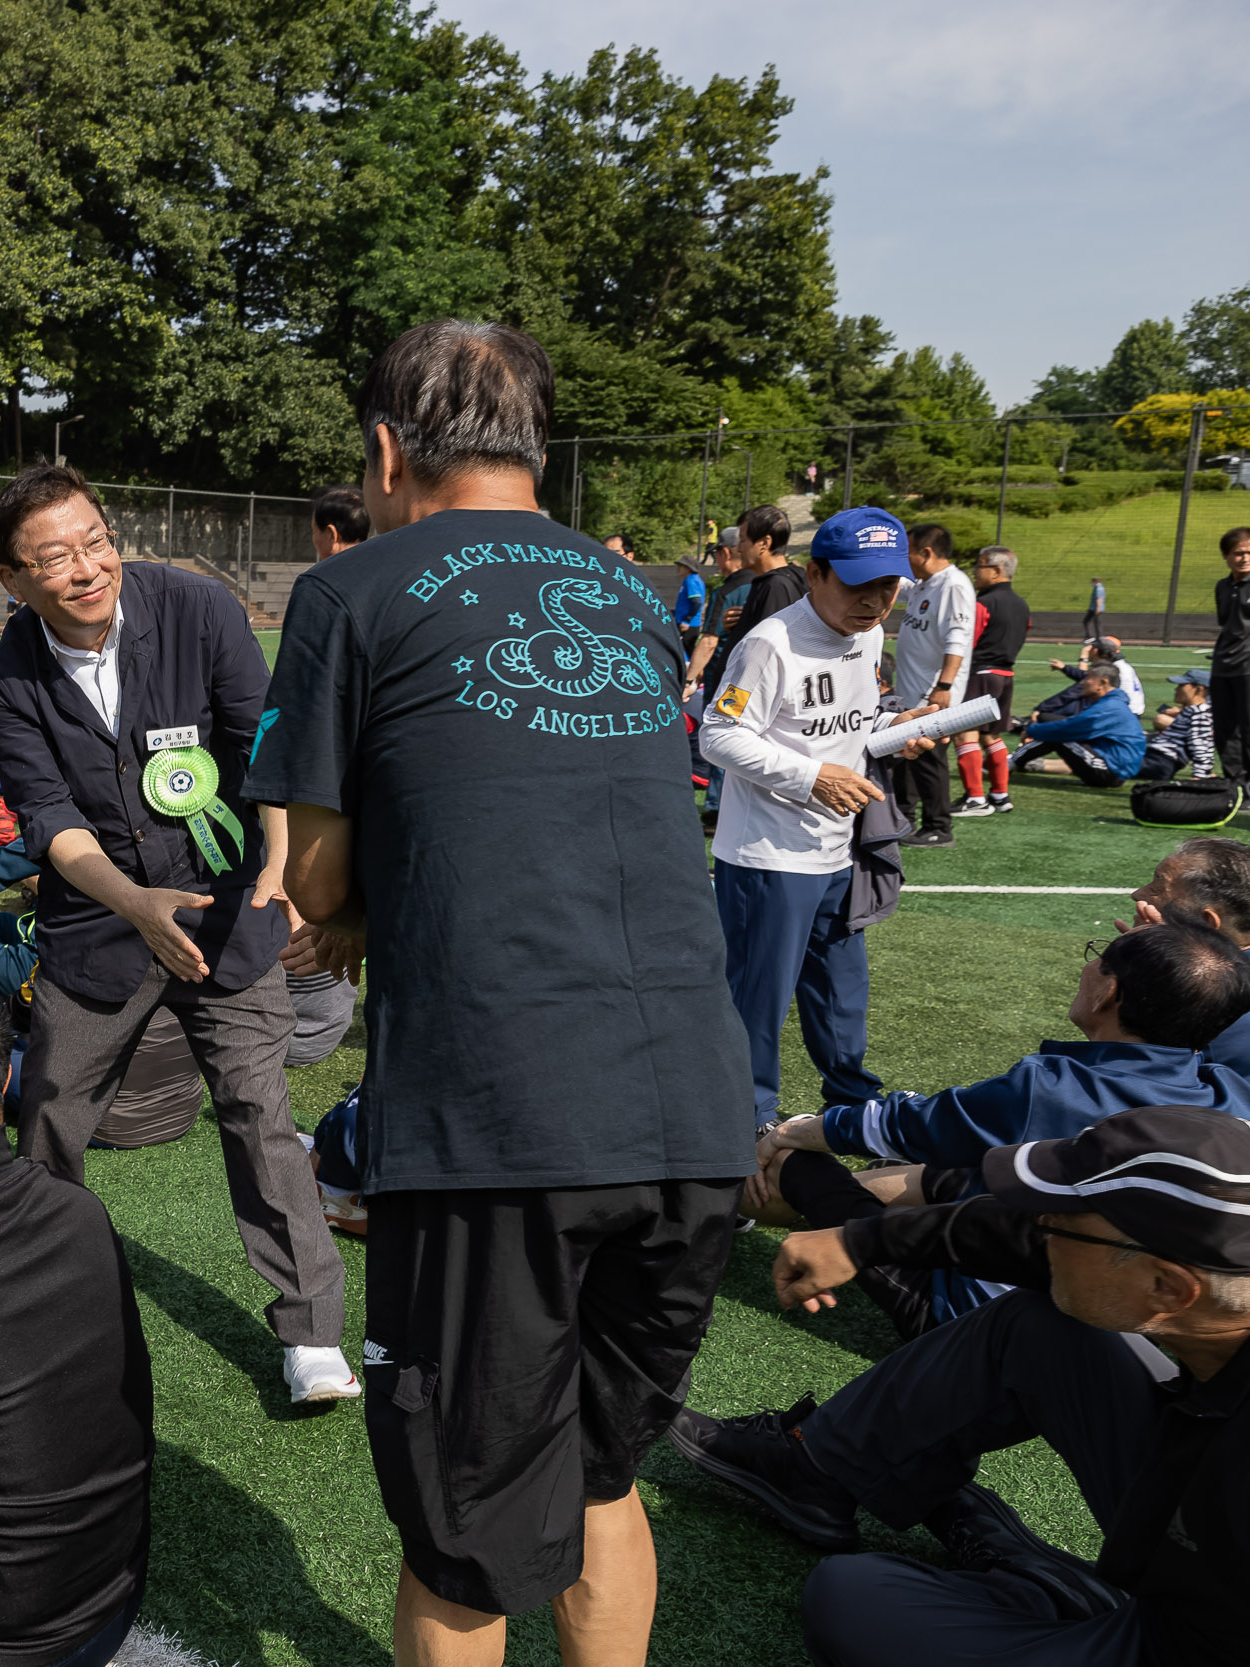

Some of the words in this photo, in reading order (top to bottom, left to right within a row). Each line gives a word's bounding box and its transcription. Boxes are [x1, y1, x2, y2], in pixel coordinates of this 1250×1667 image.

[406, 543, 505, 603] BLACK
[501, 543, 607, 574] MAMBA
[612, 566, 672, 625] ARMY
[455, 680, 518, 720] LOS
[802, 671, 836, 709] 10
[363, 1338, 388, 1361] NIKE
